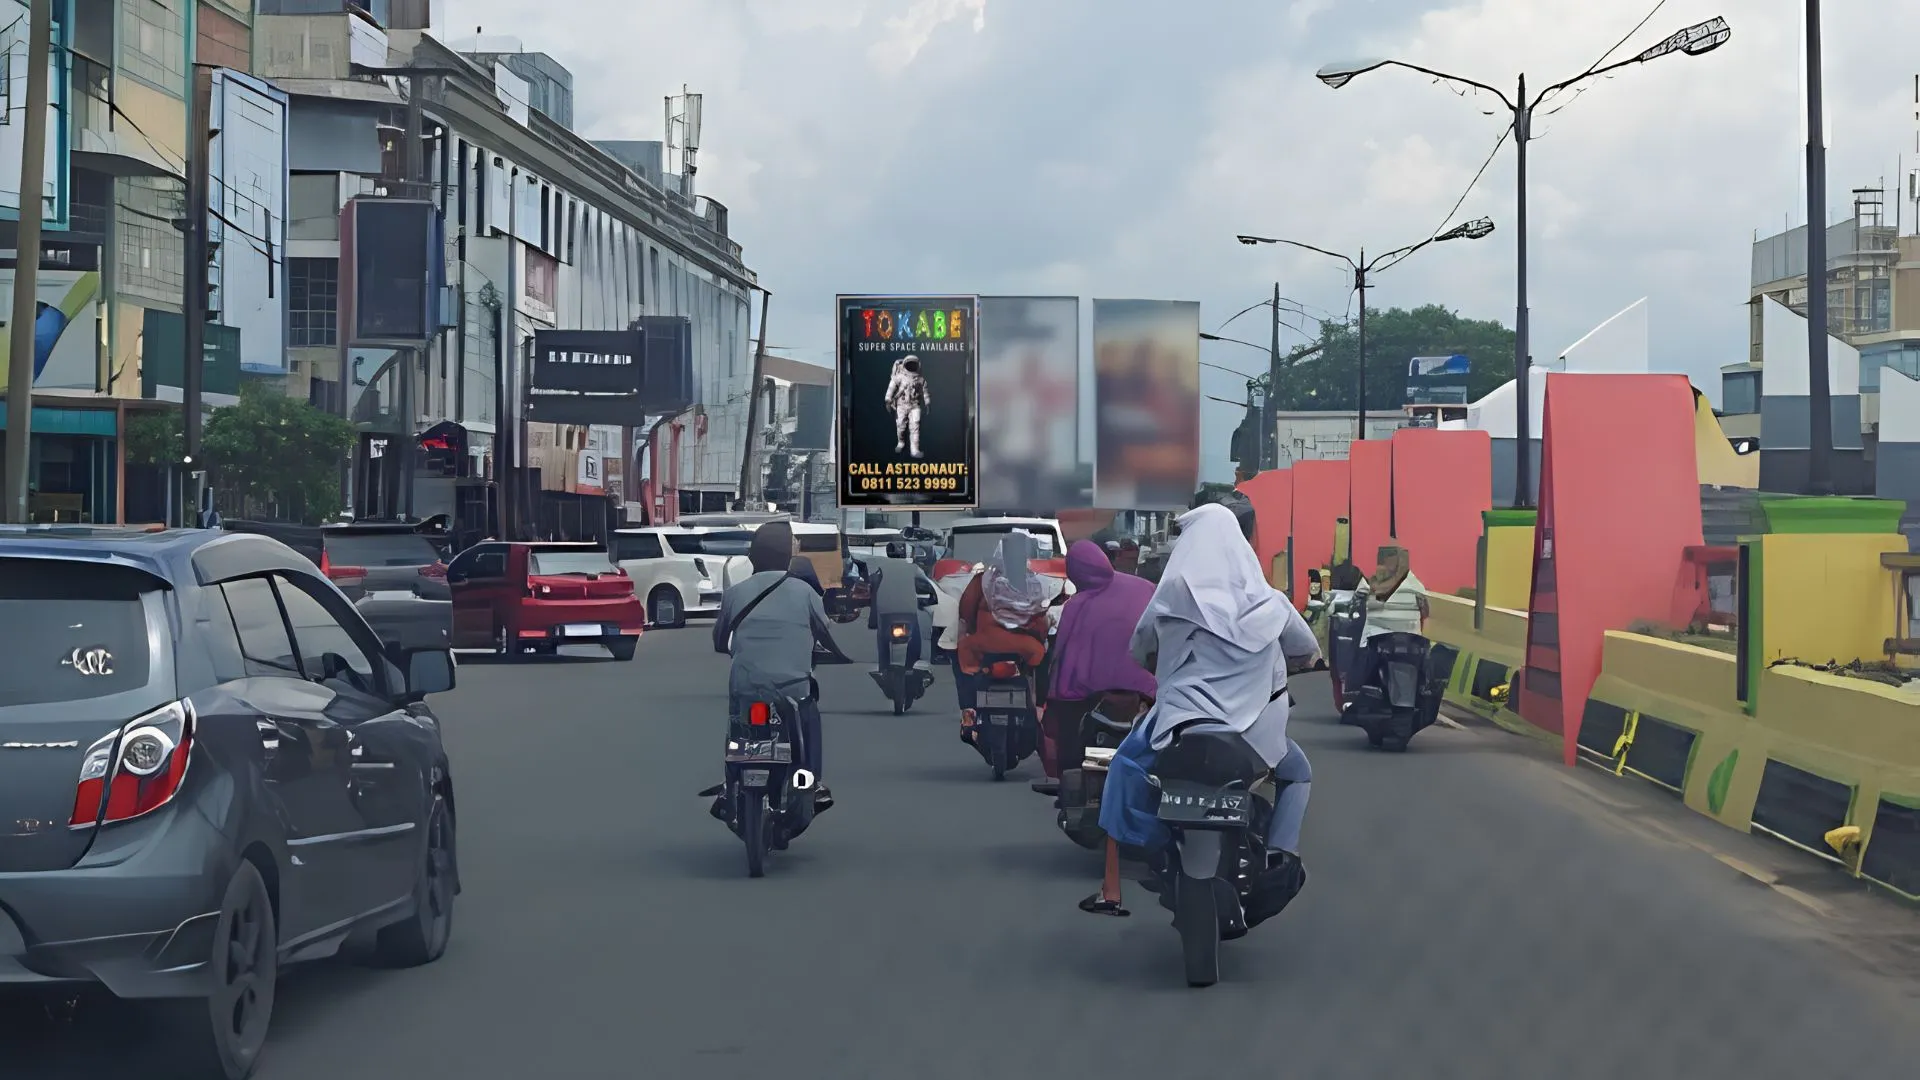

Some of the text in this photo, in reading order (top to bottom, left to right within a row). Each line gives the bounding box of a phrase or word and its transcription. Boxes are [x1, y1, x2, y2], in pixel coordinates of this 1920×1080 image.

[862, 309, 961, 339] TOKABE
[858, 342, 965, 352] SUPER SPACE AVAILABLE
[848, 463, 968, 475] CALL ASTRONAUT:
[861, 477, 957, 490] 0811 523 9999
